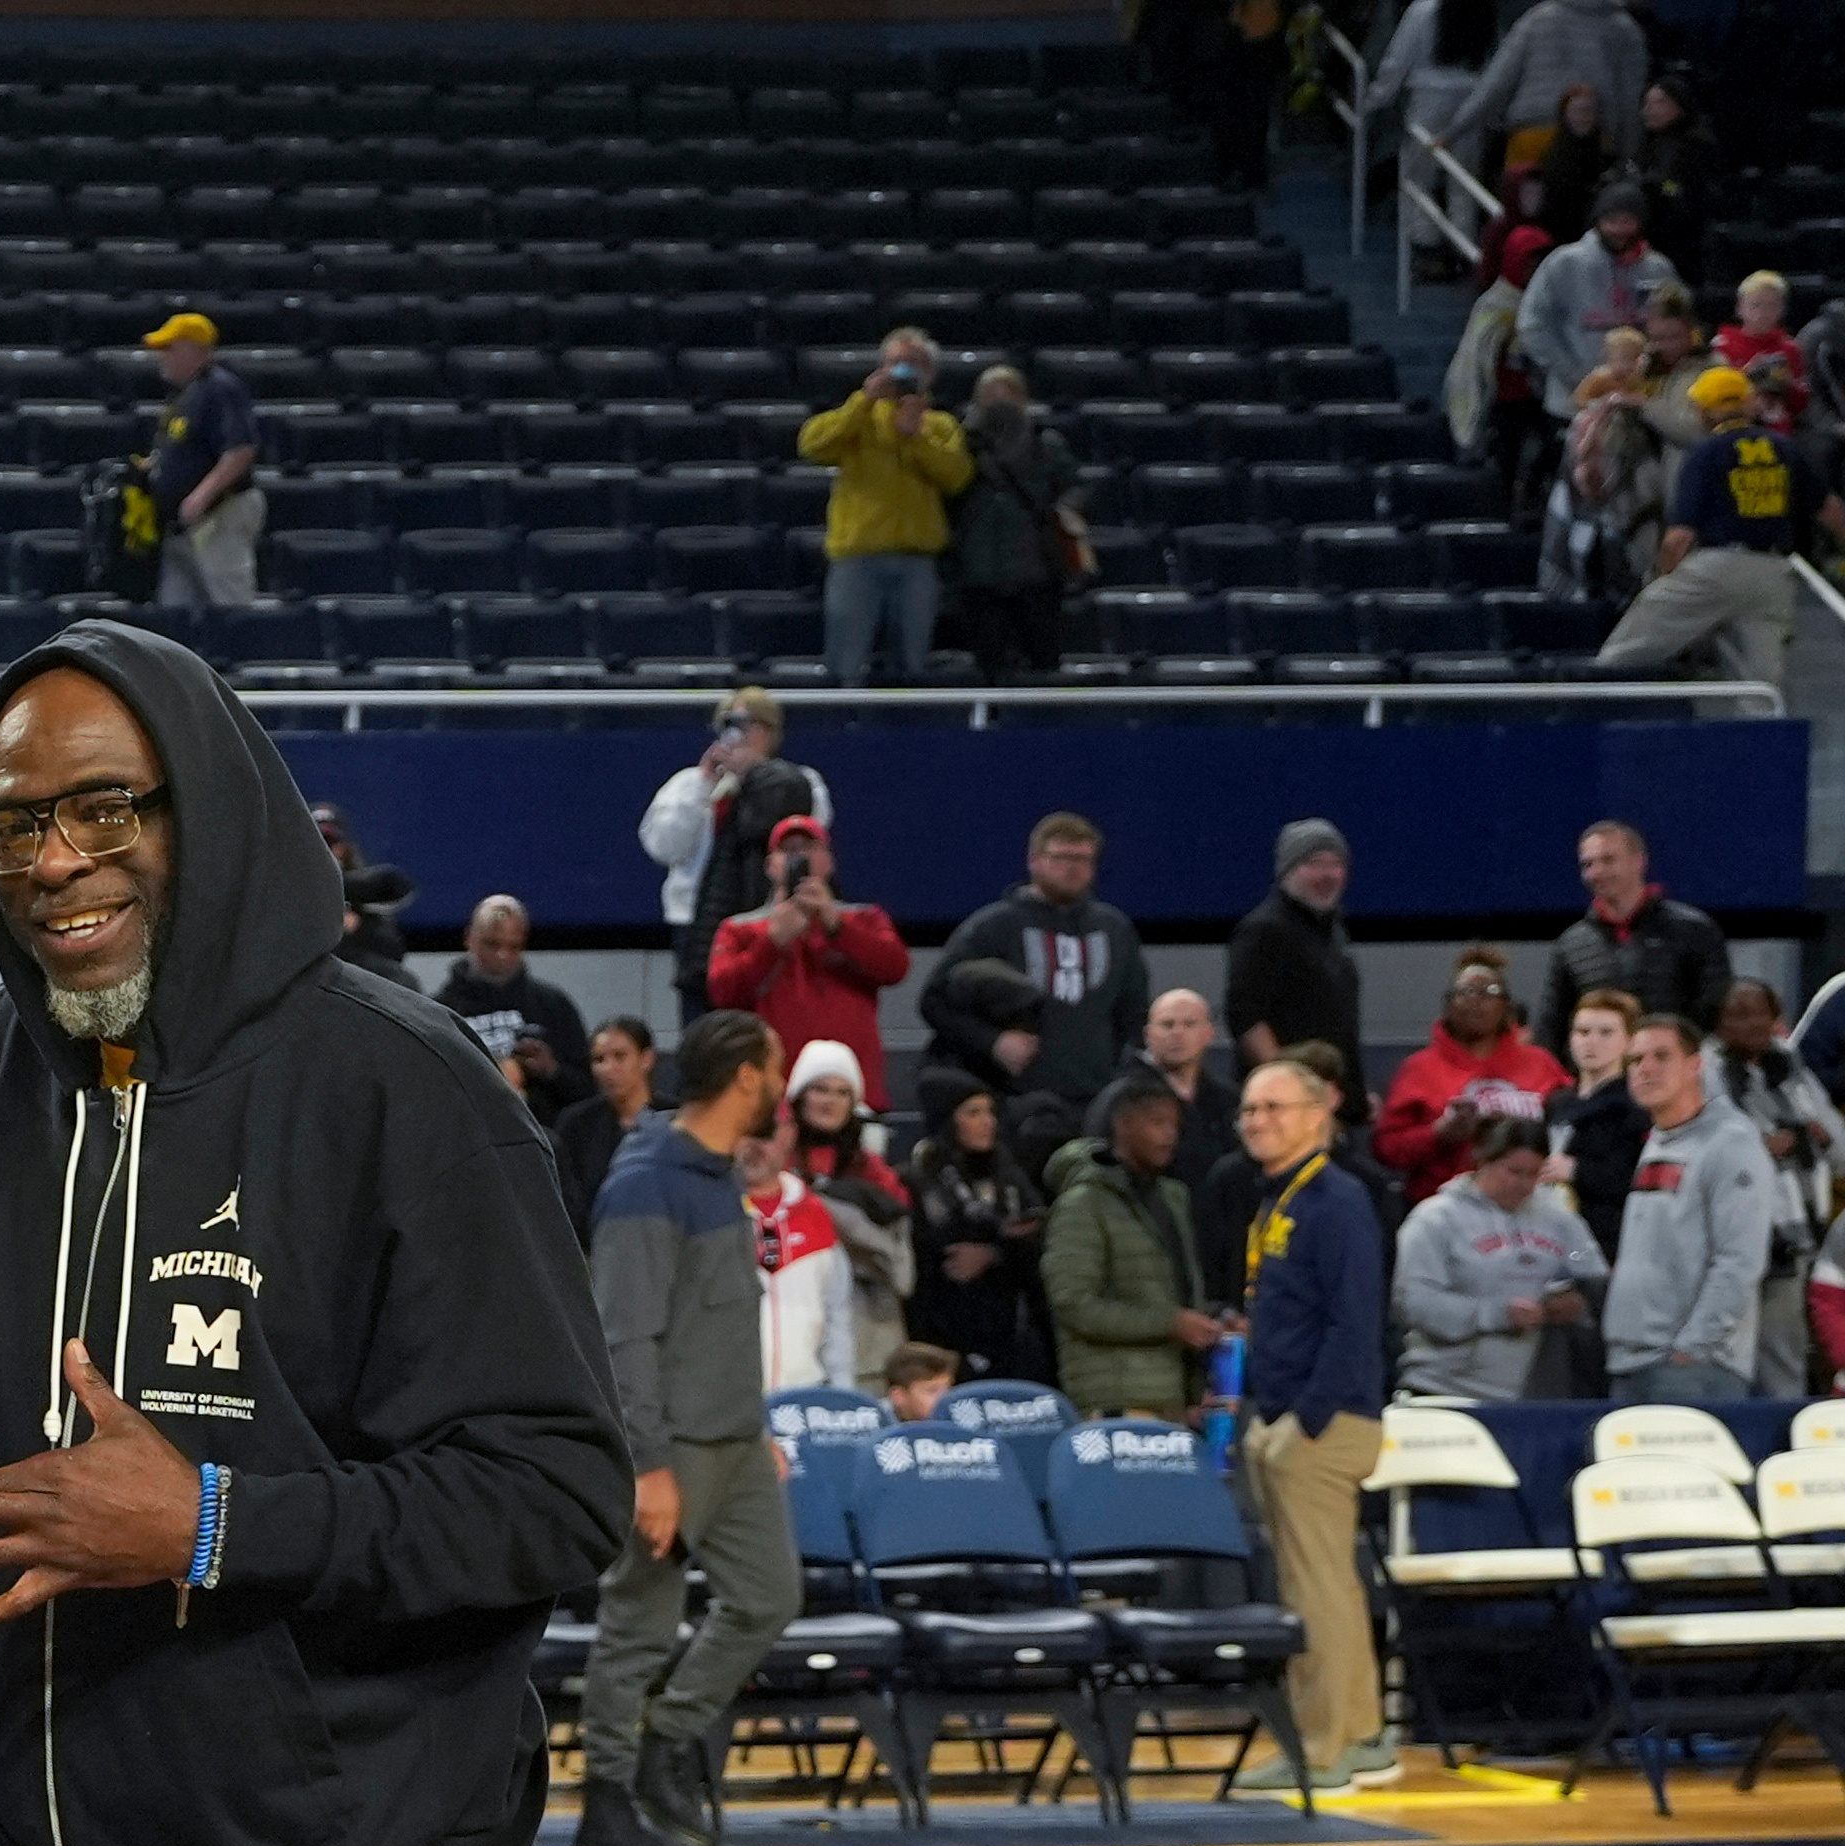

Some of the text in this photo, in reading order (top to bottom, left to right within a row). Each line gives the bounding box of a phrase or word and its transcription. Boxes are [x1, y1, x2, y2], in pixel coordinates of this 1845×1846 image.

[166, 1303, 241, 1370] M
[141, 1389, 255, 1409] UNIVERSITY OF MICHIGAN
[140, 1400, 254, 1420] WOLVERINE BASKETBALL
